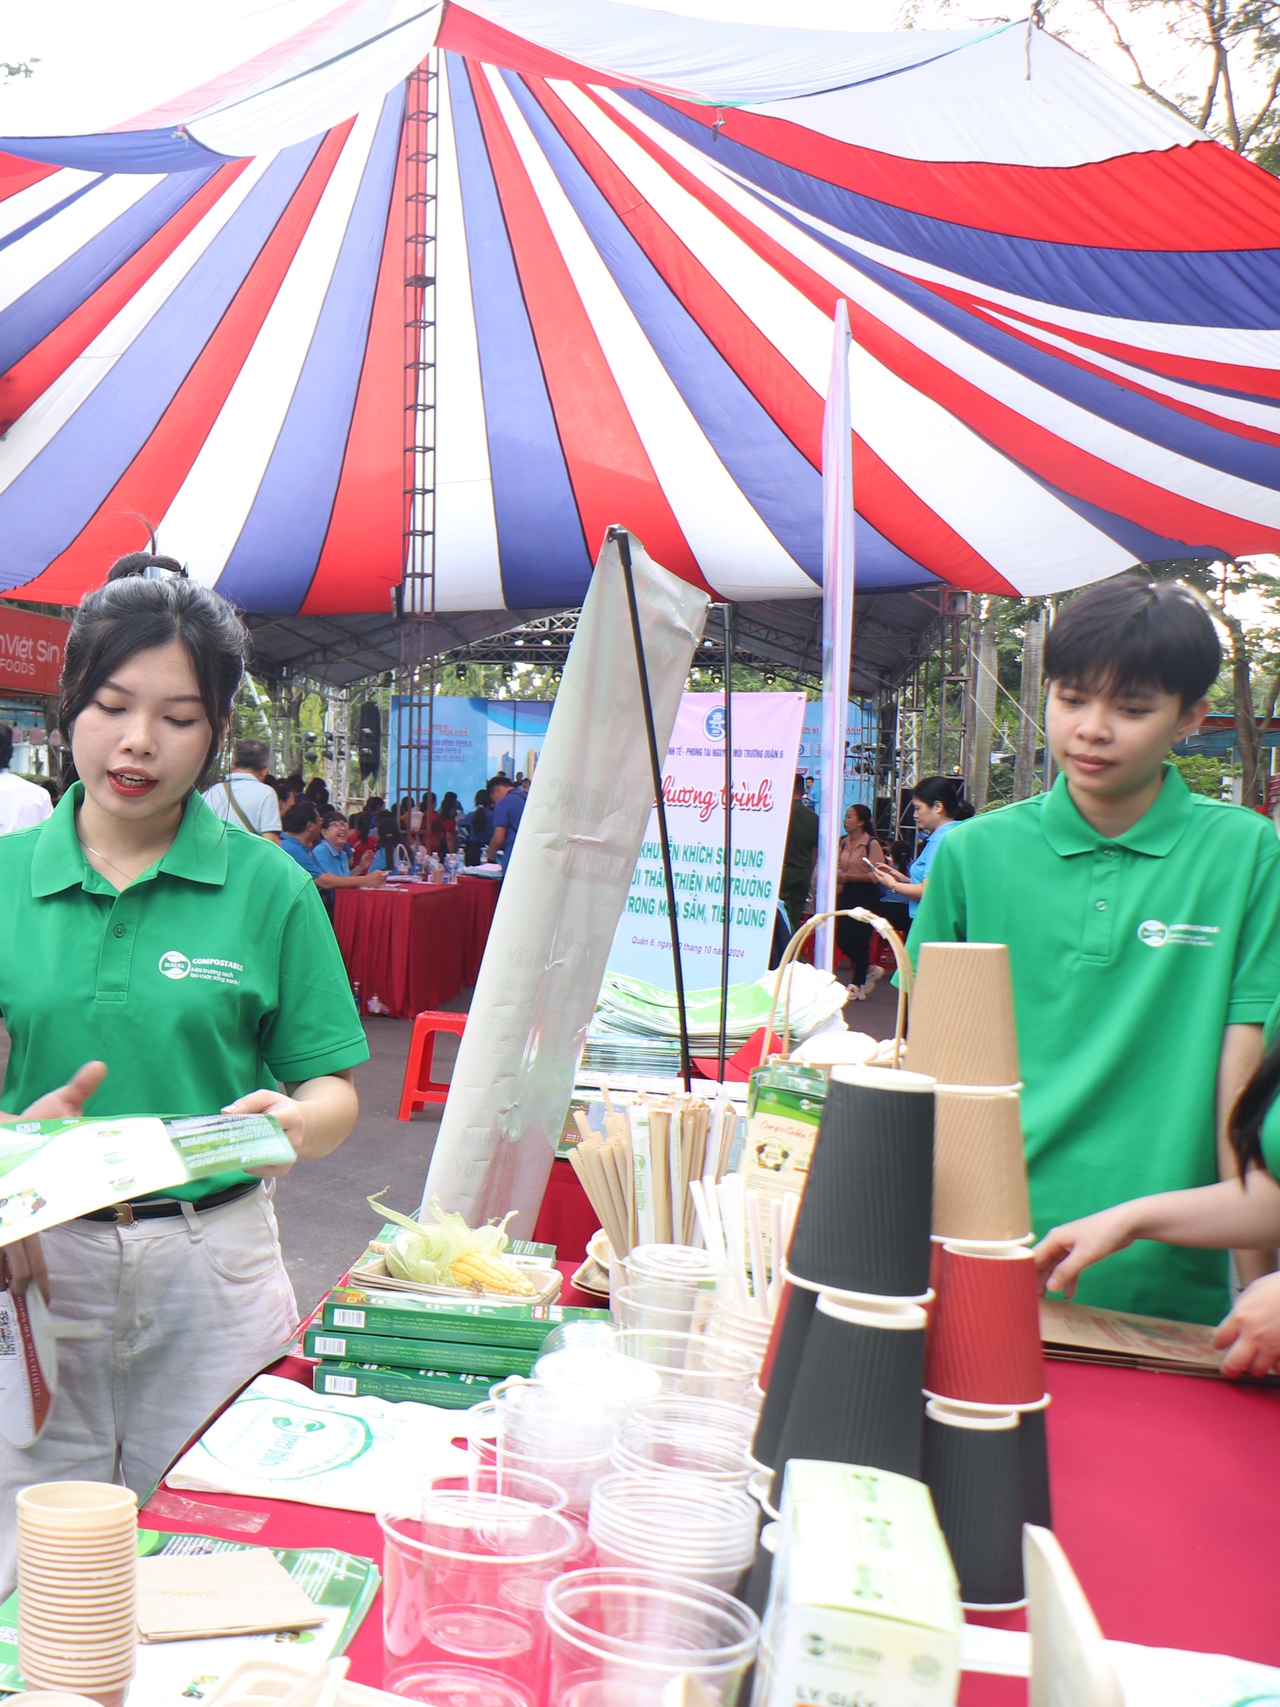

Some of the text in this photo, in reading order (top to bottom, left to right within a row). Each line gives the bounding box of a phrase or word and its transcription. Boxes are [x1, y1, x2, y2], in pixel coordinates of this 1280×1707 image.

[686, 745, 703, 757] PHÒNG
[764, 748, 779, 760] QUẬN
[779, 750, 784, 759] 6
[657, 775, 716, 819] hương
[681, 841, 713, 864] KHÍCH
[733, 849, 764, 872] DỤNG
[673, 869, 703, 897] THIỆN
[736, 903, 766, 928] DÙNG
[631, 936, 649, 946] Quận
[683, 942, 703, 955] tháng
[704, 945, 712, 954] 10
[728, 948, 745, 959] 2024
[192, 957, 244, 972] COMPOSTABLE
[202, 968, 222, 977] trường
